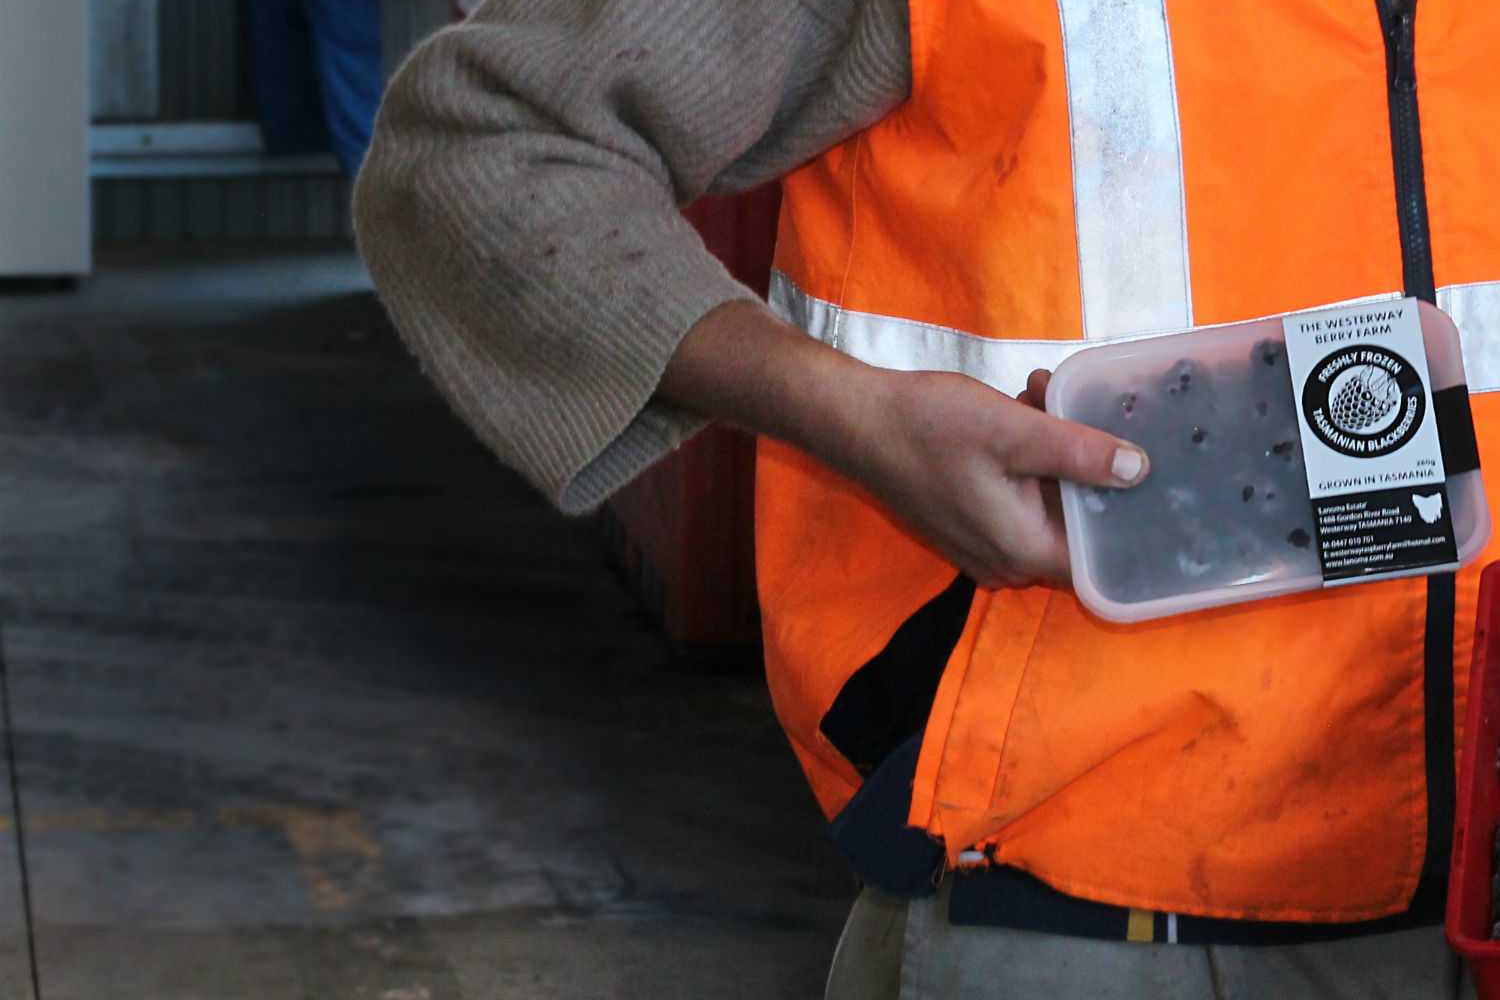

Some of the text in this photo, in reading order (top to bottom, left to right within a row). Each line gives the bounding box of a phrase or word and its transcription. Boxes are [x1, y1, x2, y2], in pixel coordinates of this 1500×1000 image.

[1300, 309, 1404, 333] THE WESTERWAY
[1315, 325, 1392, 344] BERRY FARM
[1318, 351, 1402, 383] FRESHLY FROZEN
[1313, 396, 1417, 452] TASMANIAN BLACKBERRIES
[1319, 469, 1434, 490] GROWN IN TASMANIA
